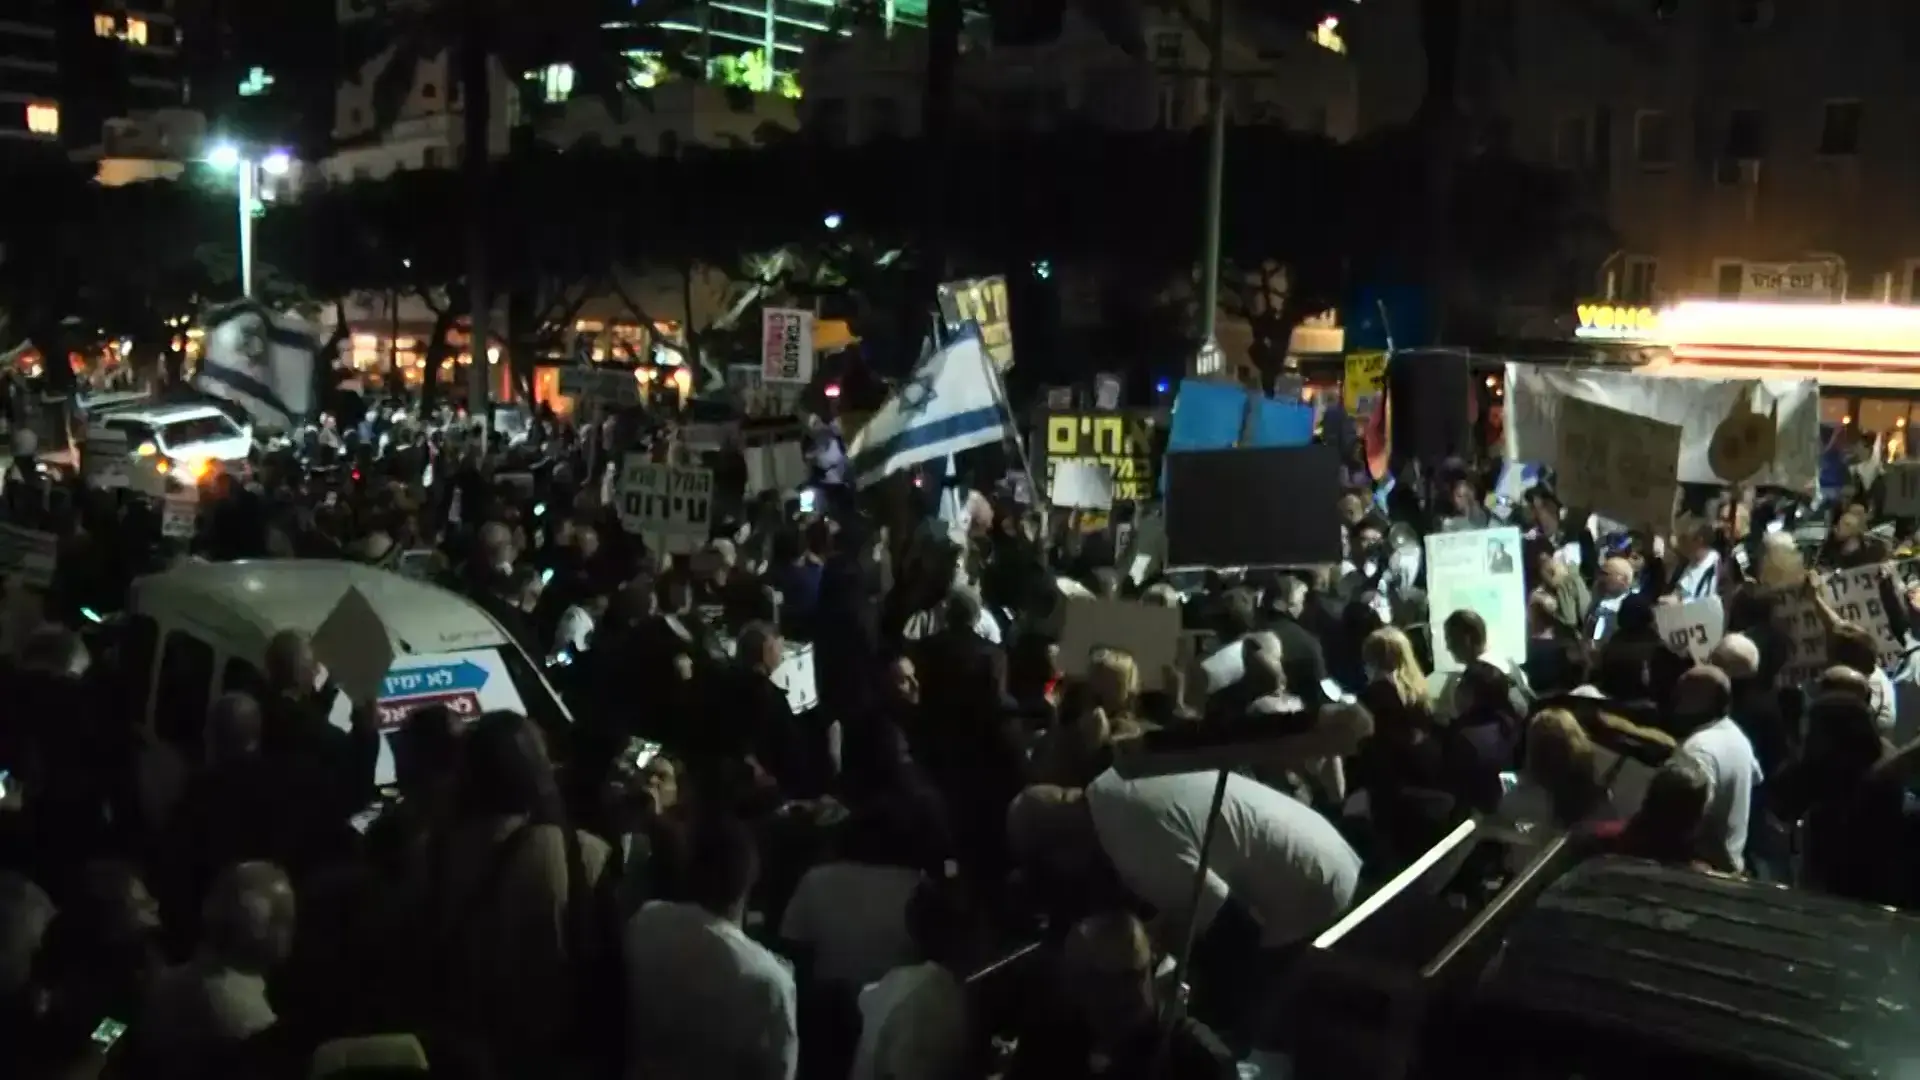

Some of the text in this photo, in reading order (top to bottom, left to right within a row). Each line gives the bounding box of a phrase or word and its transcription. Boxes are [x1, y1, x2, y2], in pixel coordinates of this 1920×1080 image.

[1047, 415, 1152, 455] אחים
[626, 491, 708, 521] עירום
[385, 669, 453, 694] לא ימין
